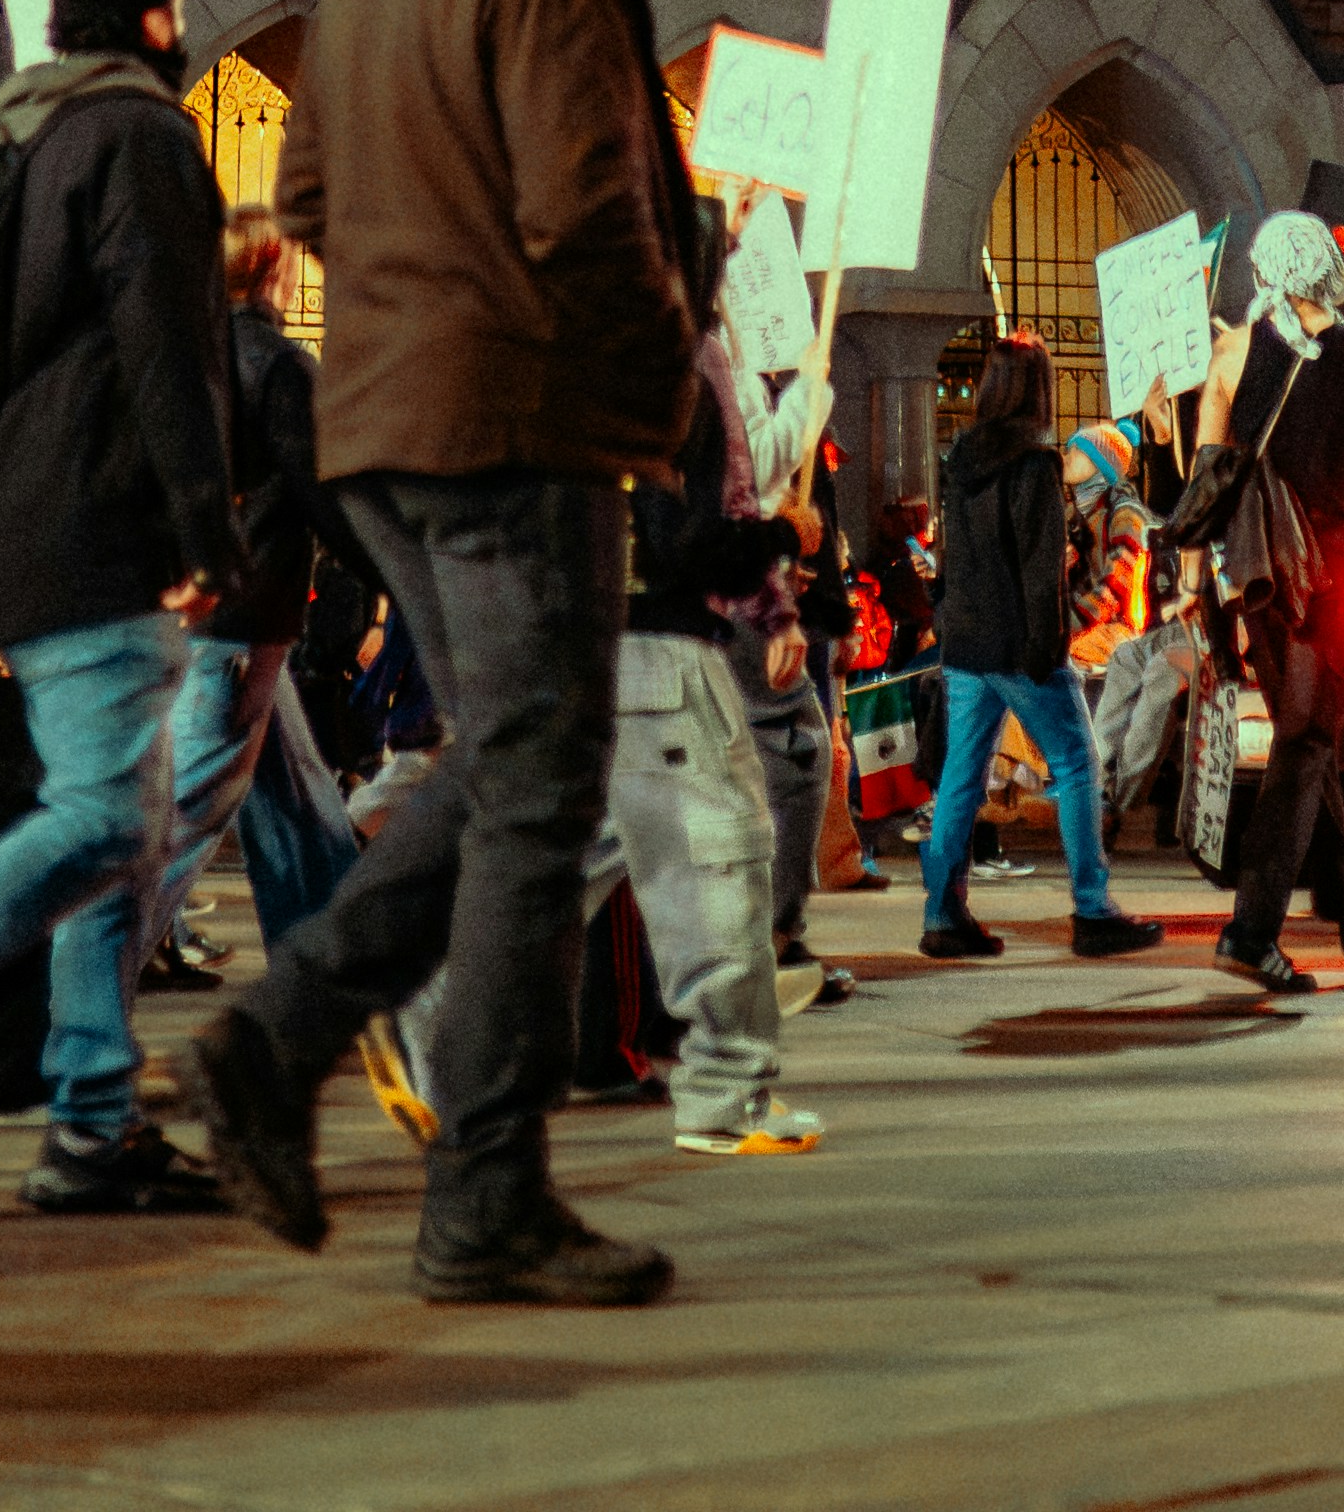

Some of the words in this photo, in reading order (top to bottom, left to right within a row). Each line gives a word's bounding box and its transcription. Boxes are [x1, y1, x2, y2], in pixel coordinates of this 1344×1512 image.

[1111, 270, 1201, 347] CONVICT
[1120, 329, 1200, 399] EXILE
[1206, 704, 1224, 795] EGAL
